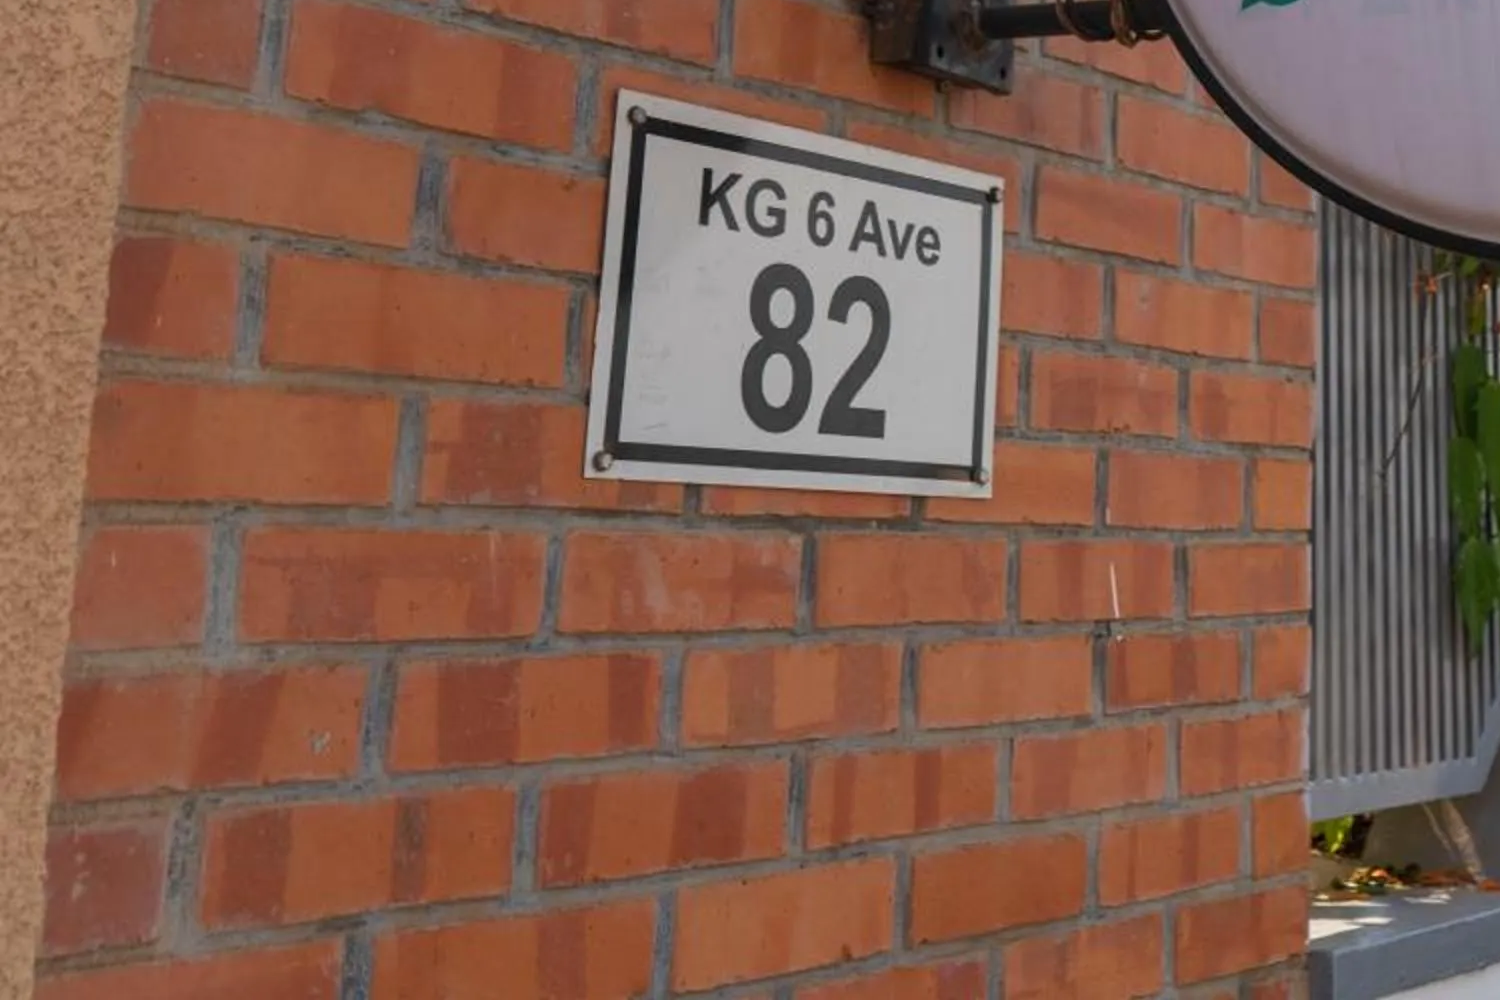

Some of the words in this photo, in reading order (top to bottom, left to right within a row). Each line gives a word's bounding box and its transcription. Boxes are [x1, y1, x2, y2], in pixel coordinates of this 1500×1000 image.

[698, 167, 788, 239] KG
[807, 191, 835, 247] 6
[848, 200, 942, 266] Ave
[740, 262, 892, 439] 82
